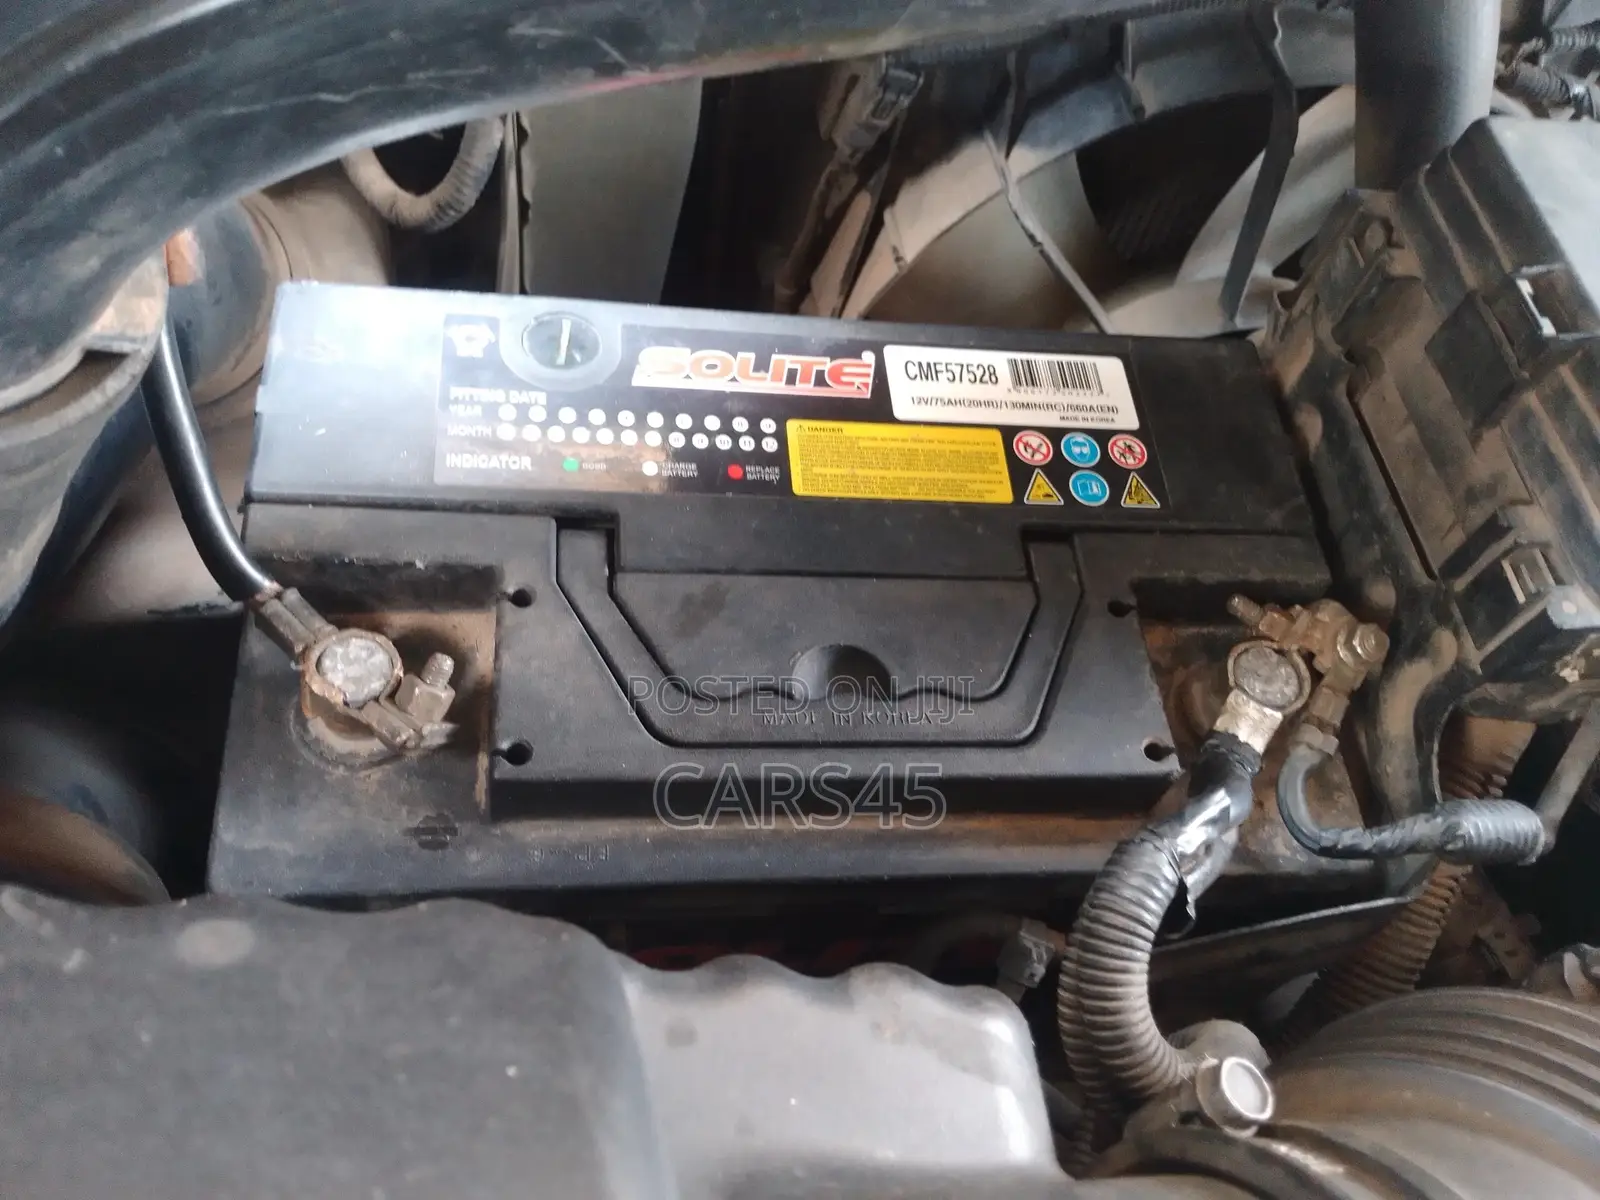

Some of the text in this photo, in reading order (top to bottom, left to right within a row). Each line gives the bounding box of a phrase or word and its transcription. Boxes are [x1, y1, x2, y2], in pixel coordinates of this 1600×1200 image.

[632, 346, 875, 398] SOLITE
[904, 360, 999, 385] CMF57528
[509, 390, 547, 405] DATE
[449, 404, 483, 417] YEAR
[447, 424, 493, 438] MONTH
[807, 426, 844, 434] DANGER
[446, 453, 532, 471] INDICATOR
[661, 468, 699, 478] BATTERY
[745, 465, 780, 474] REPLACE
[746, 472, 780, 481] BATTERY
